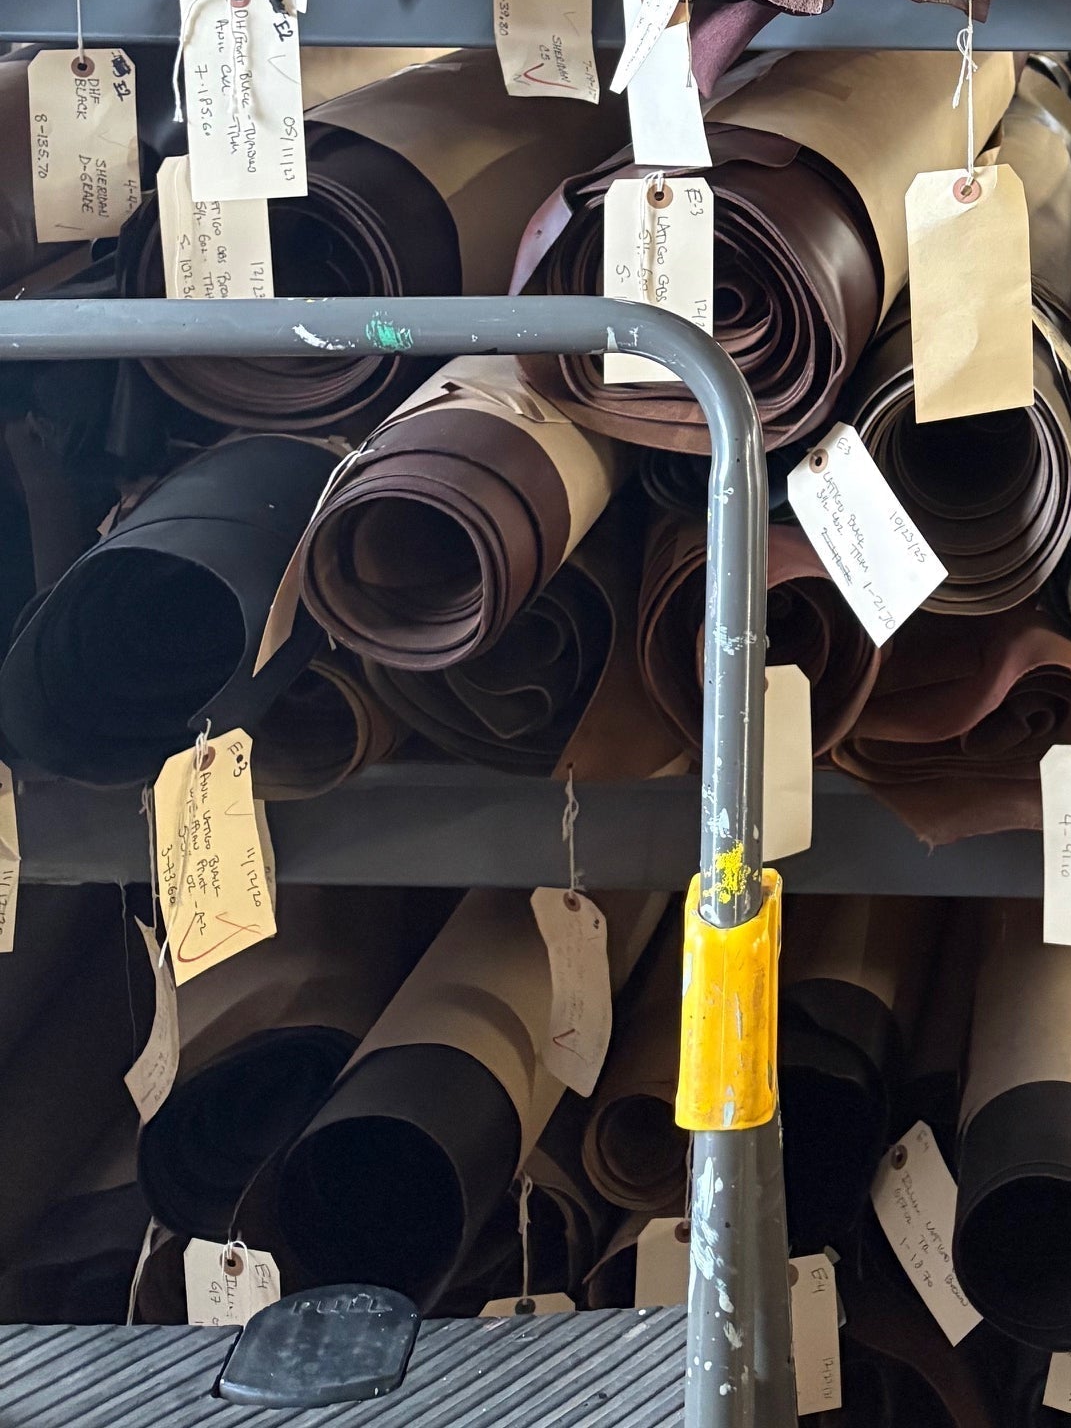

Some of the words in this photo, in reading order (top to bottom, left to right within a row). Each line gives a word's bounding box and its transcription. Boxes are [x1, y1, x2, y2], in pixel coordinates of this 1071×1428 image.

[74, 78, 86, 119] BLACK
[87, 78, 99, 104] DHF
[95, 159, 107, 217] SHERIDAN
